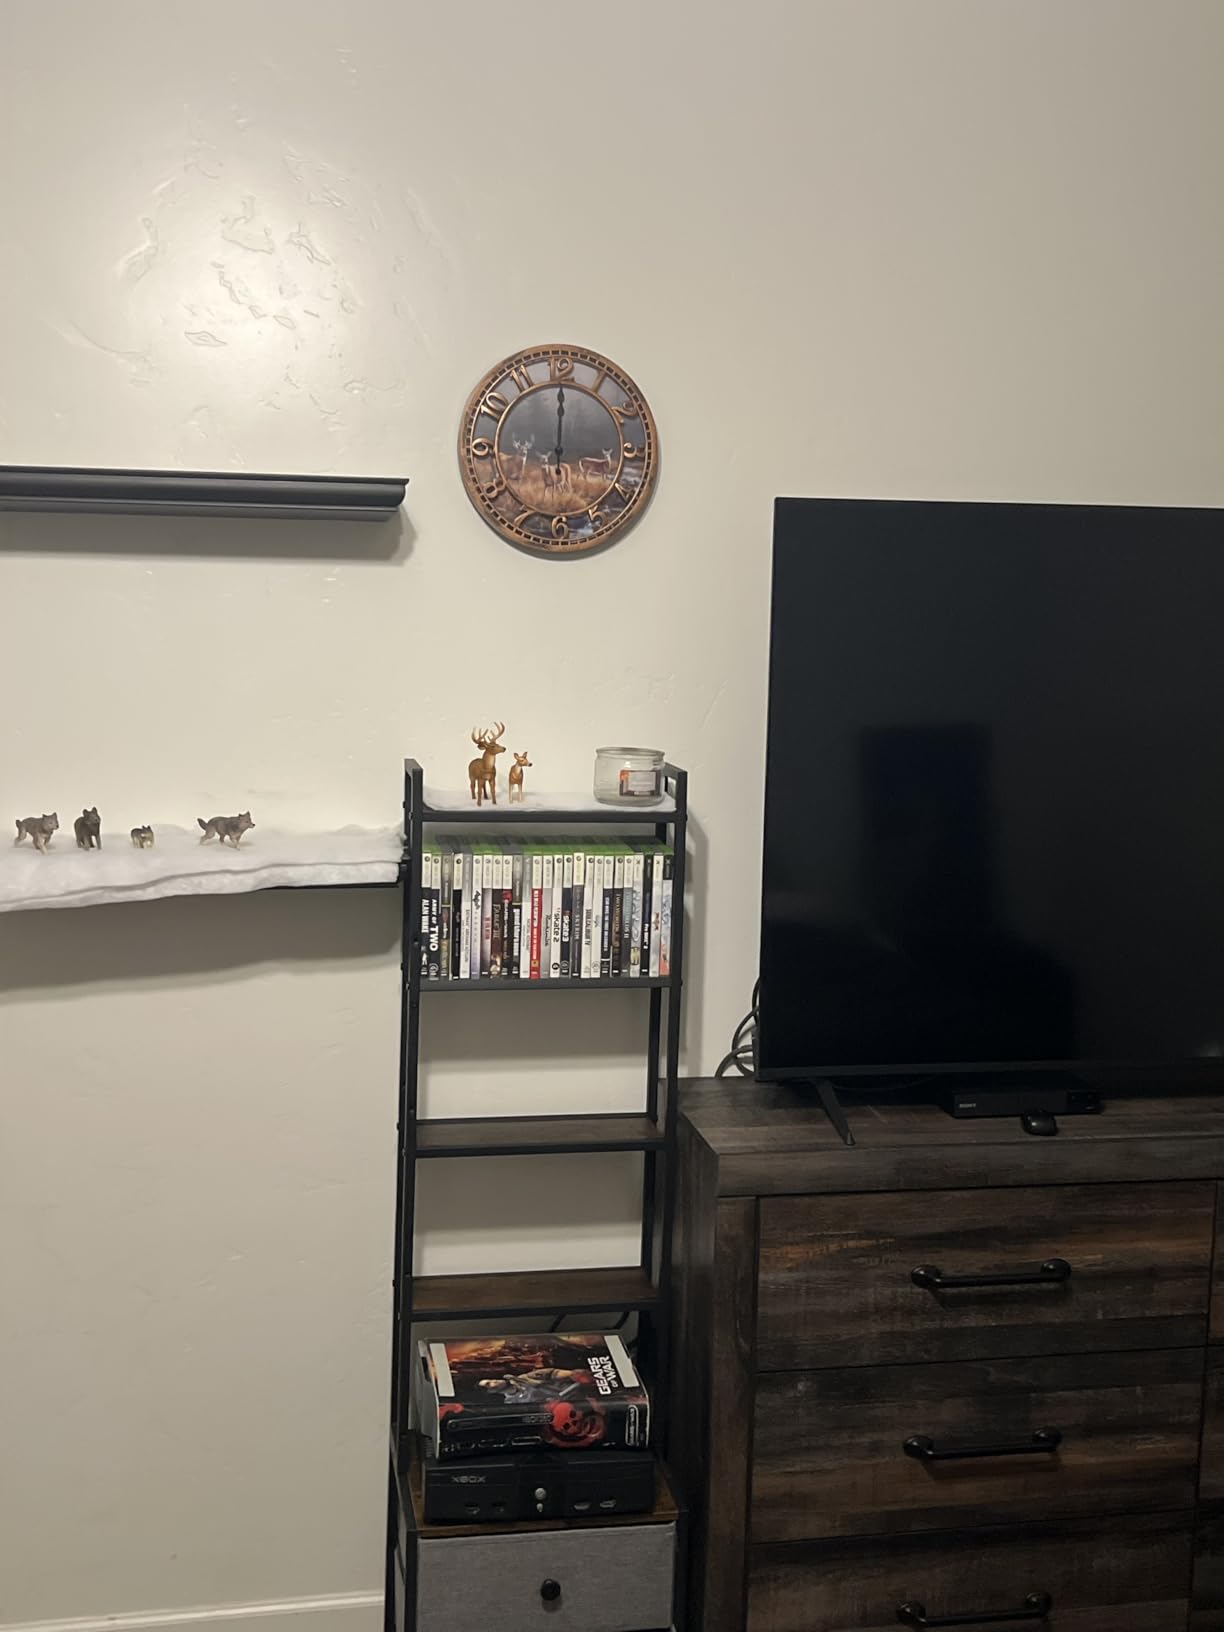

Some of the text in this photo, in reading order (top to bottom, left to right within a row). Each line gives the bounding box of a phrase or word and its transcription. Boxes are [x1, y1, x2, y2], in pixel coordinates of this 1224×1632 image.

[510, 364, 534, 393] 11
[547, 357, 576, 383] 12
[592, 367, 607, 394] 1
[480, 391, 512, 422] 10
[610, 400, 638, 424] 2
[470, 437, 497, 457] 9
[482, 478, 507, 499] 8
[613, 482, 637, 504] 4
[513, 504, 538, 529] 7
[551, 514, 570, 540] 6
[588, 504, 607, 529] 5
[421, 898, 430, 933] ALAN WAKE
[492, 903, 501, 938] FABLE III
[553, 912, 561, 936] skate
[429, 925, 439, 951] TWO
[587, 1357, 612, 1395] GEARS
[599, 1355, 618, 1388] OF WAR
[451, 1475, 487, 1484] XBOX
